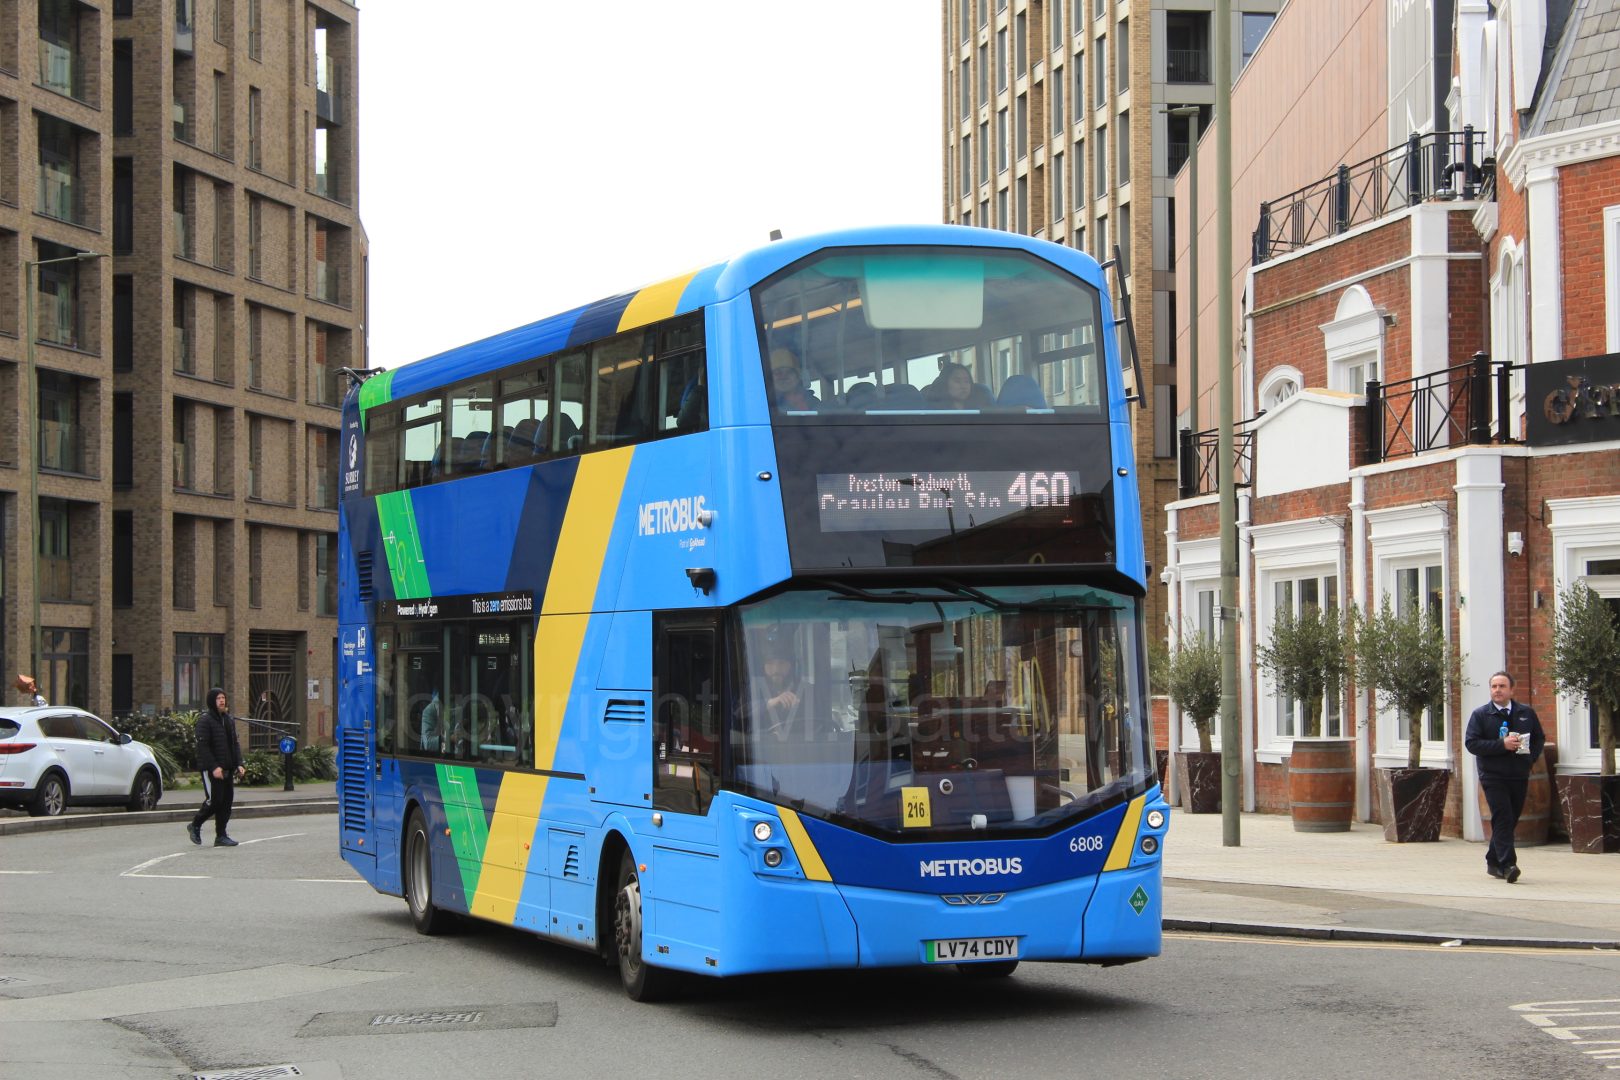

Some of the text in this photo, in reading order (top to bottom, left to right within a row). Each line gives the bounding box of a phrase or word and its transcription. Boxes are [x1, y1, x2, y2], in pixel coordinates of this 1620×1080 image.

[849, 473, 972, 492] Preston Tadworth
[1007, 472, 1070, 507] 460
[638, 495, 706, 536] METROBUS
[397, 604, 415, 615] Powered
[472, 594, 532, 613] This is a zero emissions bus
[907, 802, 925, 818] 216
[1069, 835, 1103, 852] 6808
[920, 857, 1023, 877] METROBUS
[937, 939, 1015, 959] LV74 CDY
